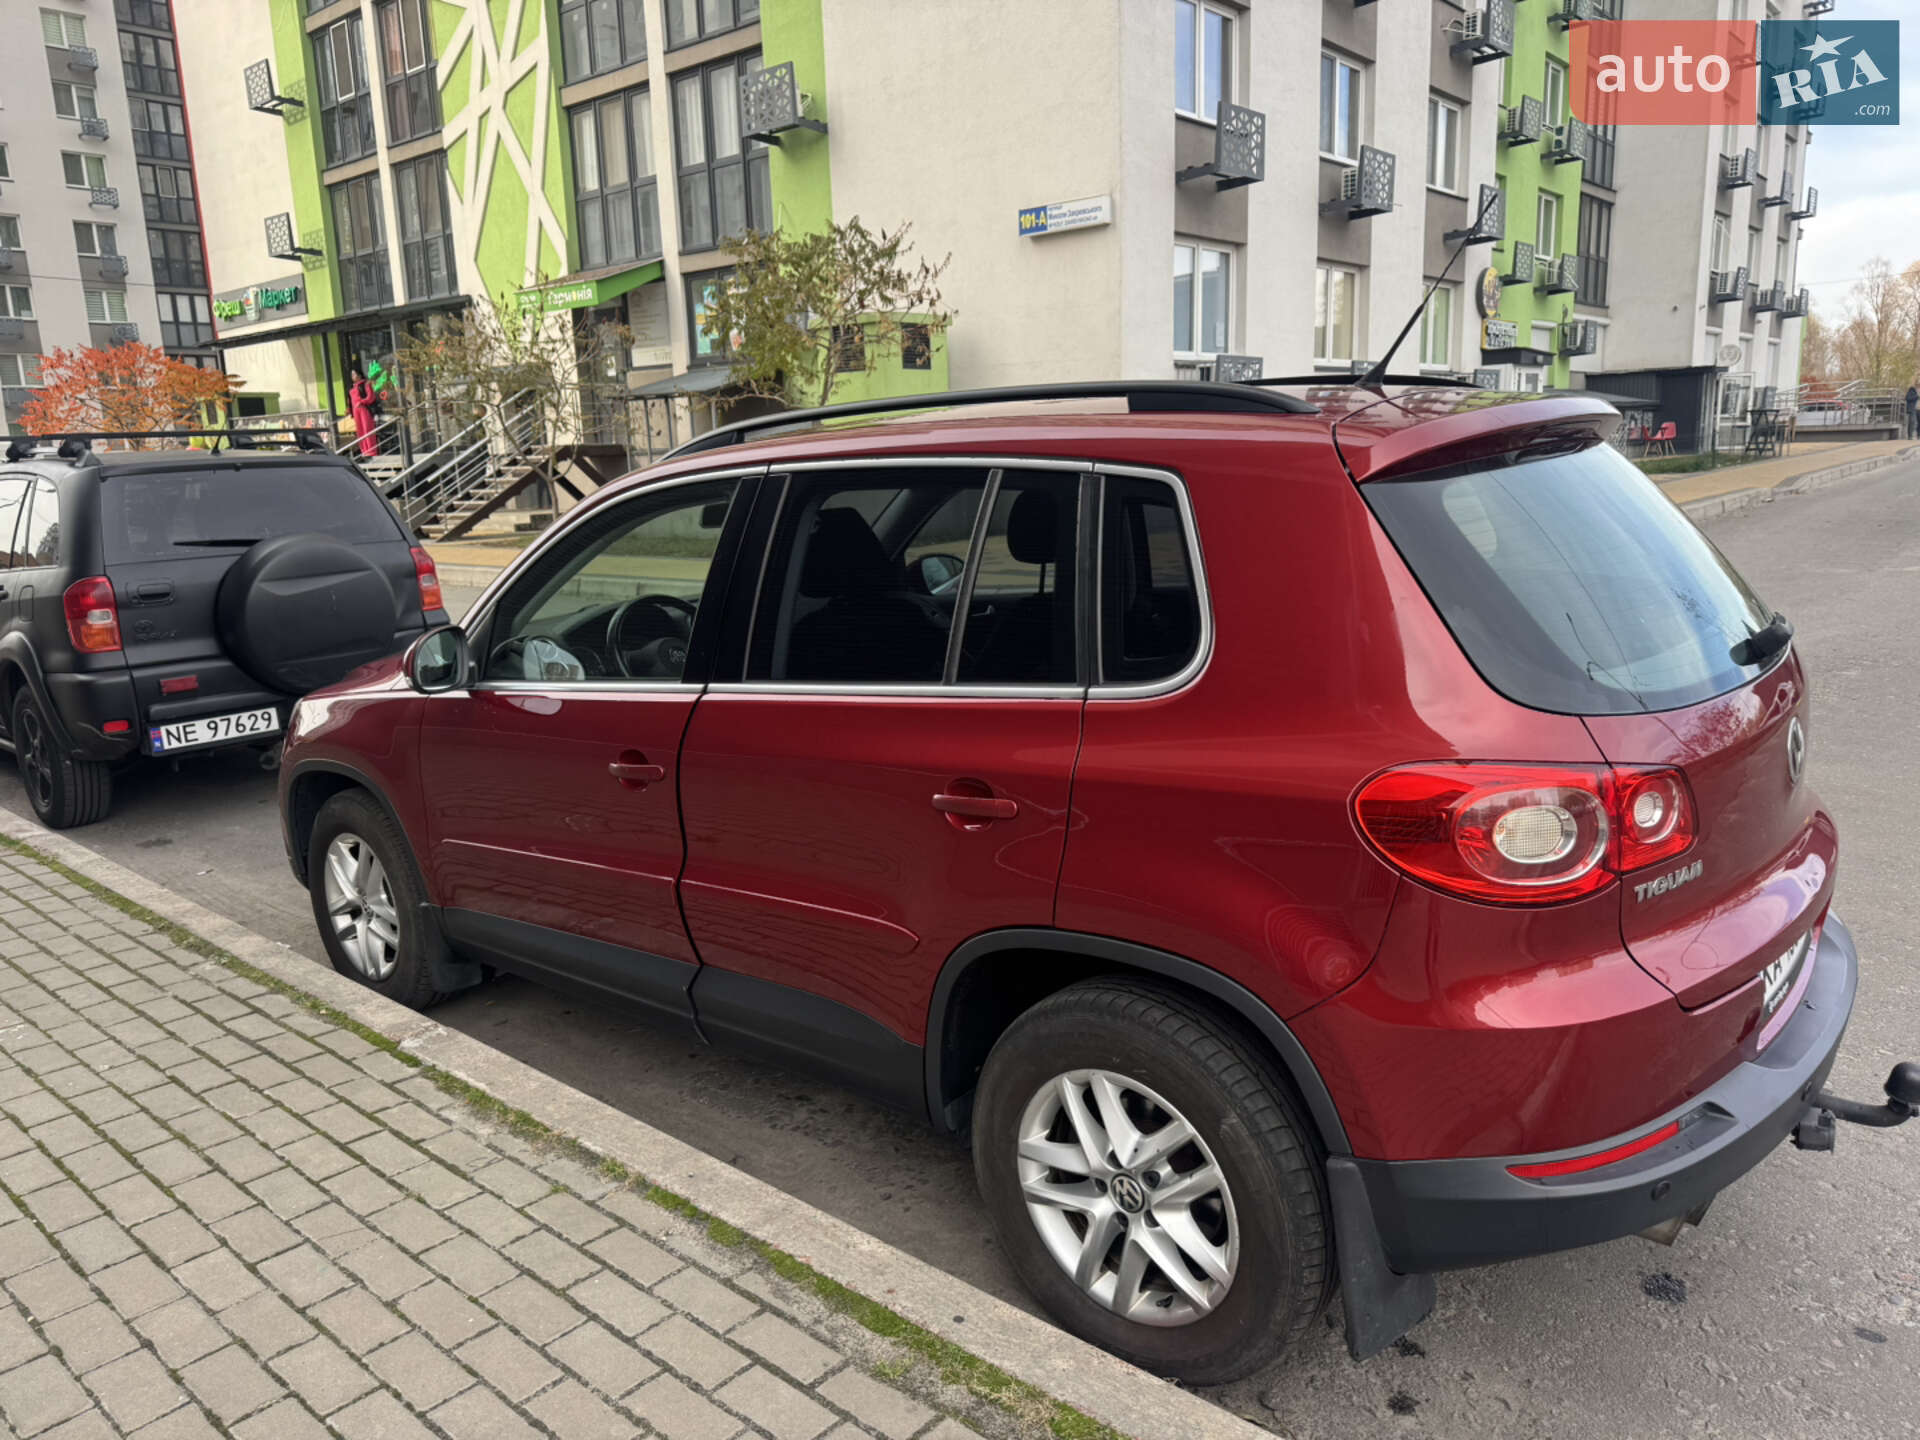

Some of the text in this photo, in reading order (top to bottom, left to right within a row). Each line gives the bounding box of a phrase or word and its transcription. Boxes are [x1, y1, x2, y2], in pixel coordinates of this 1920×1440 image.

[164, 711, 272, 746] NE 97629
[1634, 859, 1703, 904] TIGUAN
